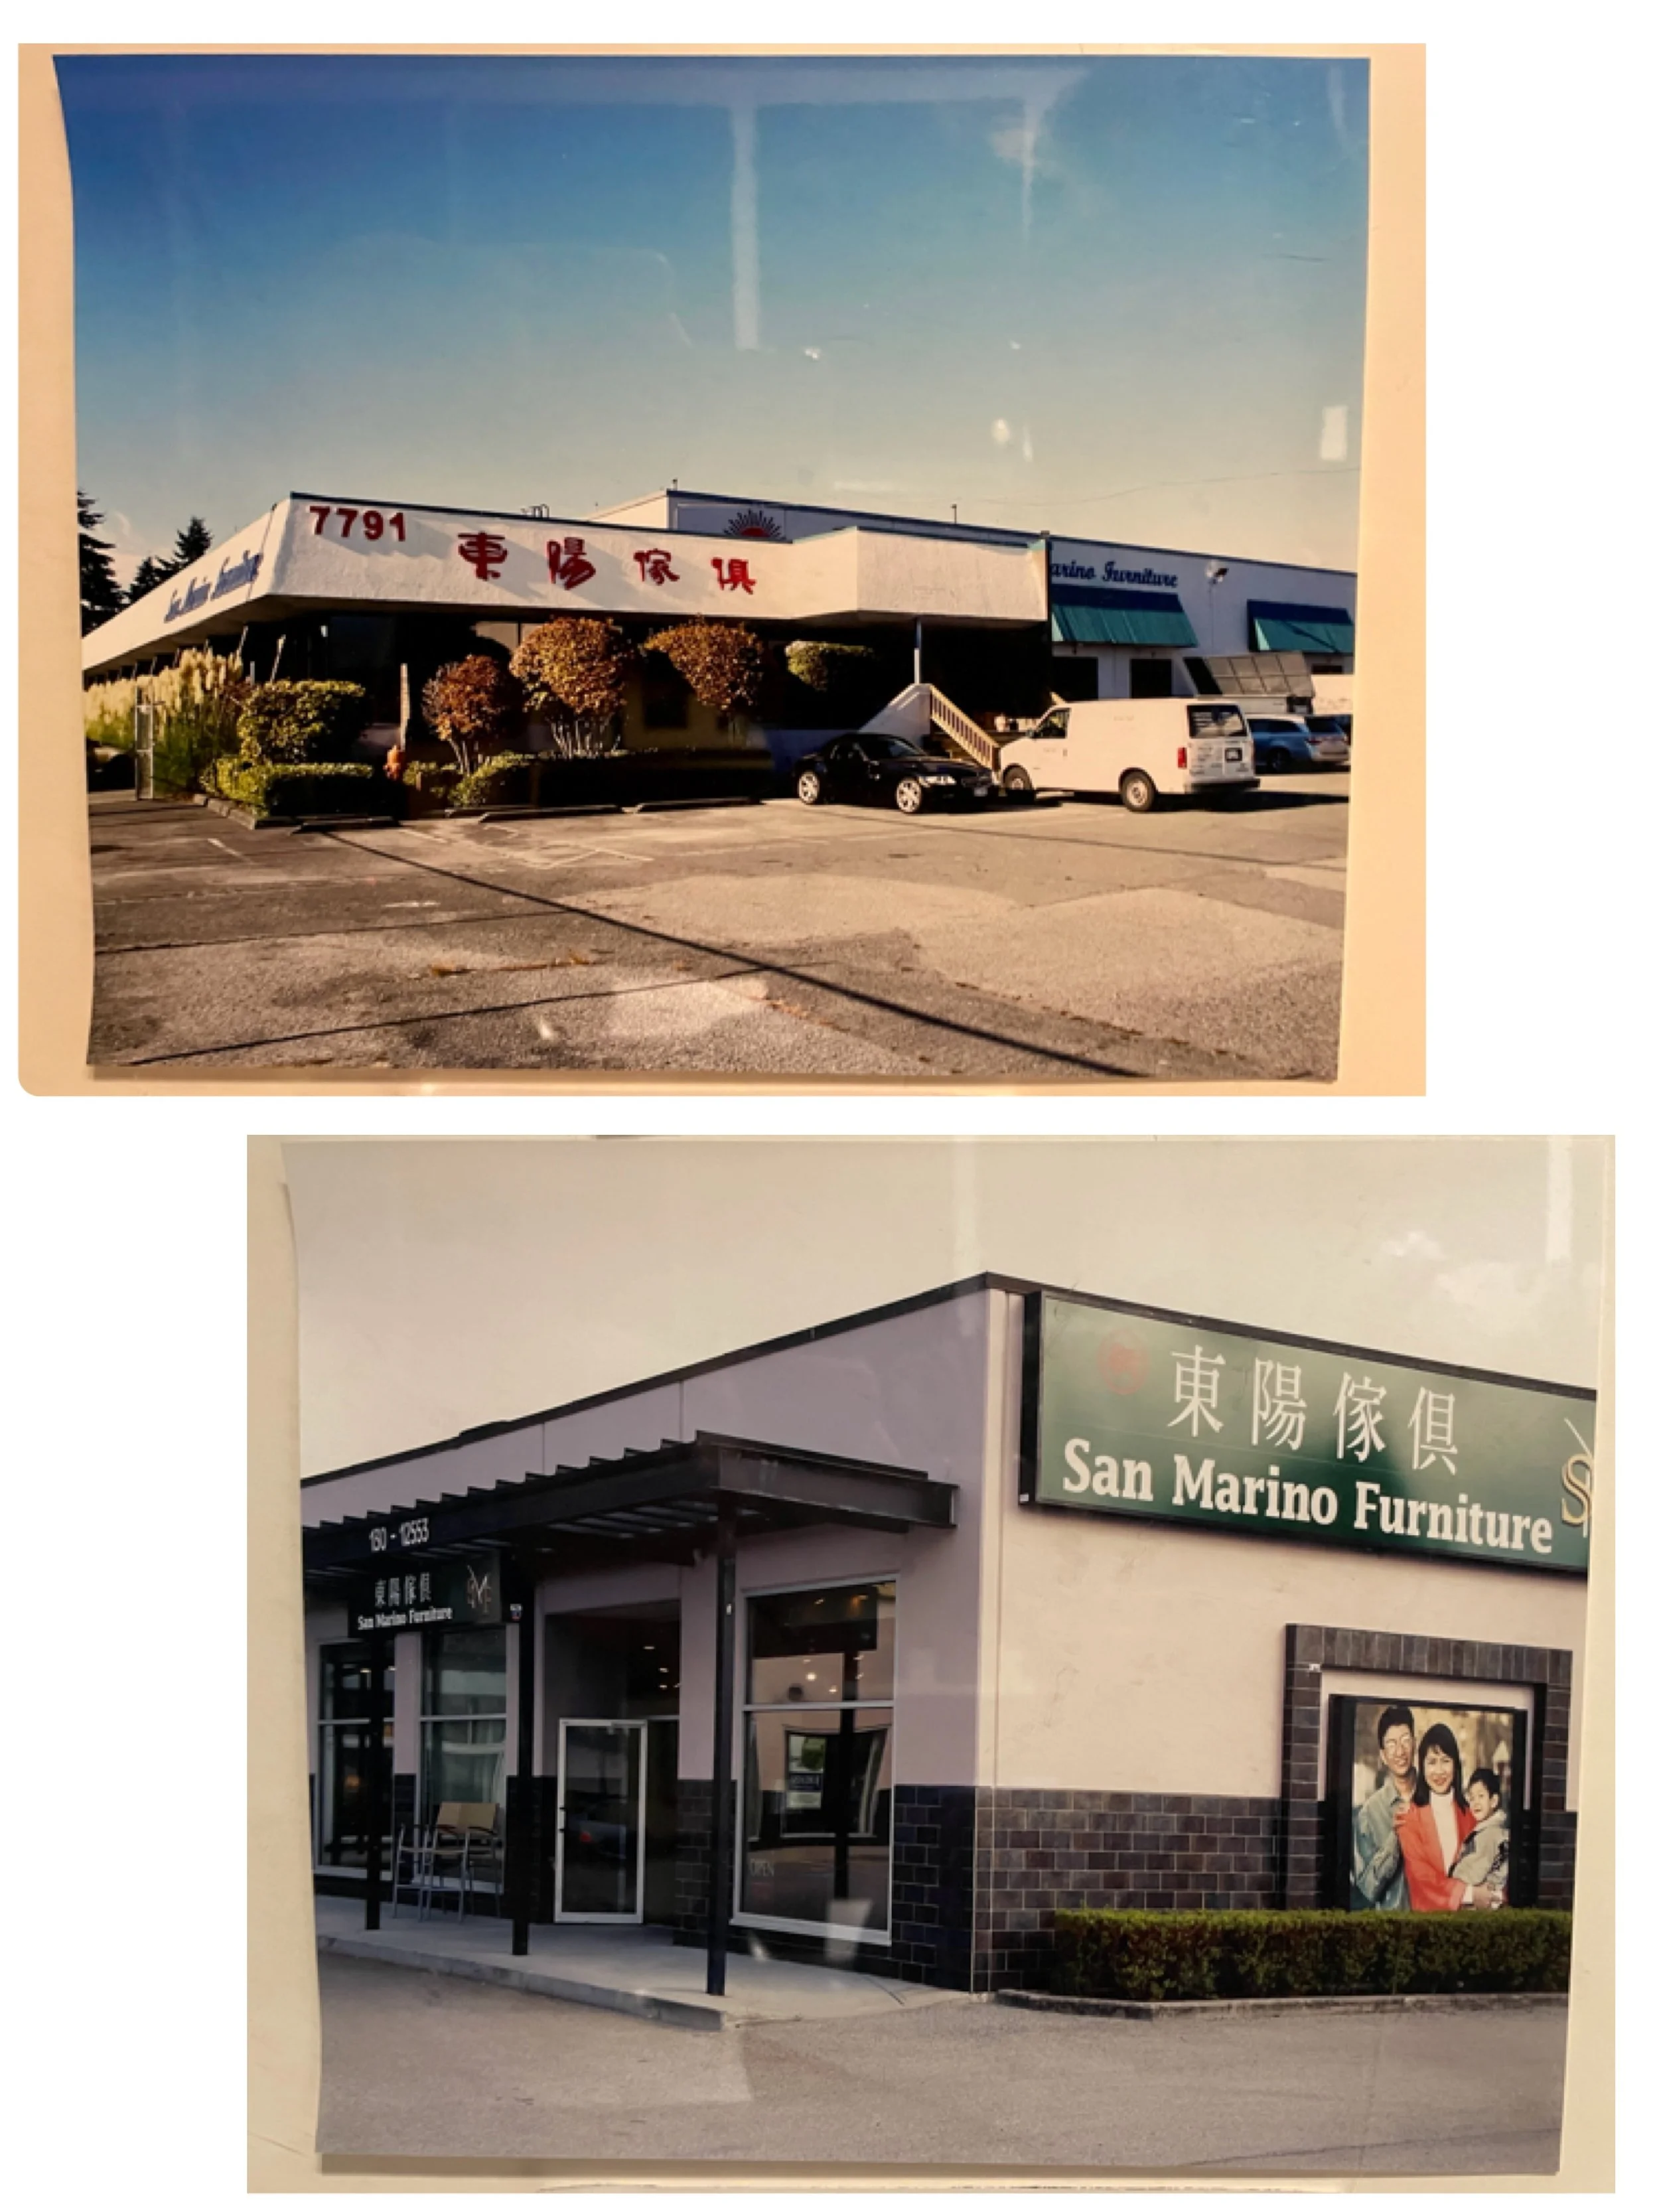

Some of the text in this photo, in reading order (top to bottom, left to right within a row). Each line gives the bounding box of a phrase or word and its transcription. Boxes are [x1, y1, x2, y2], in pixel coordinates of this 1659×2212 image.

[310, 506, 406, 542] 7791
[458, 532, 757, 594] 東陽傢俱
[1050, 559, 1179, 588] arino Furniture
[1167, 1345, 1459, 1475] 東陽傢俱
[1063, 1438, 1553, 1554] San Marino Furniture
[399, 1518, 429, 1546] 12553
[358, 1605, 453, 1630] San Marino Furniture
